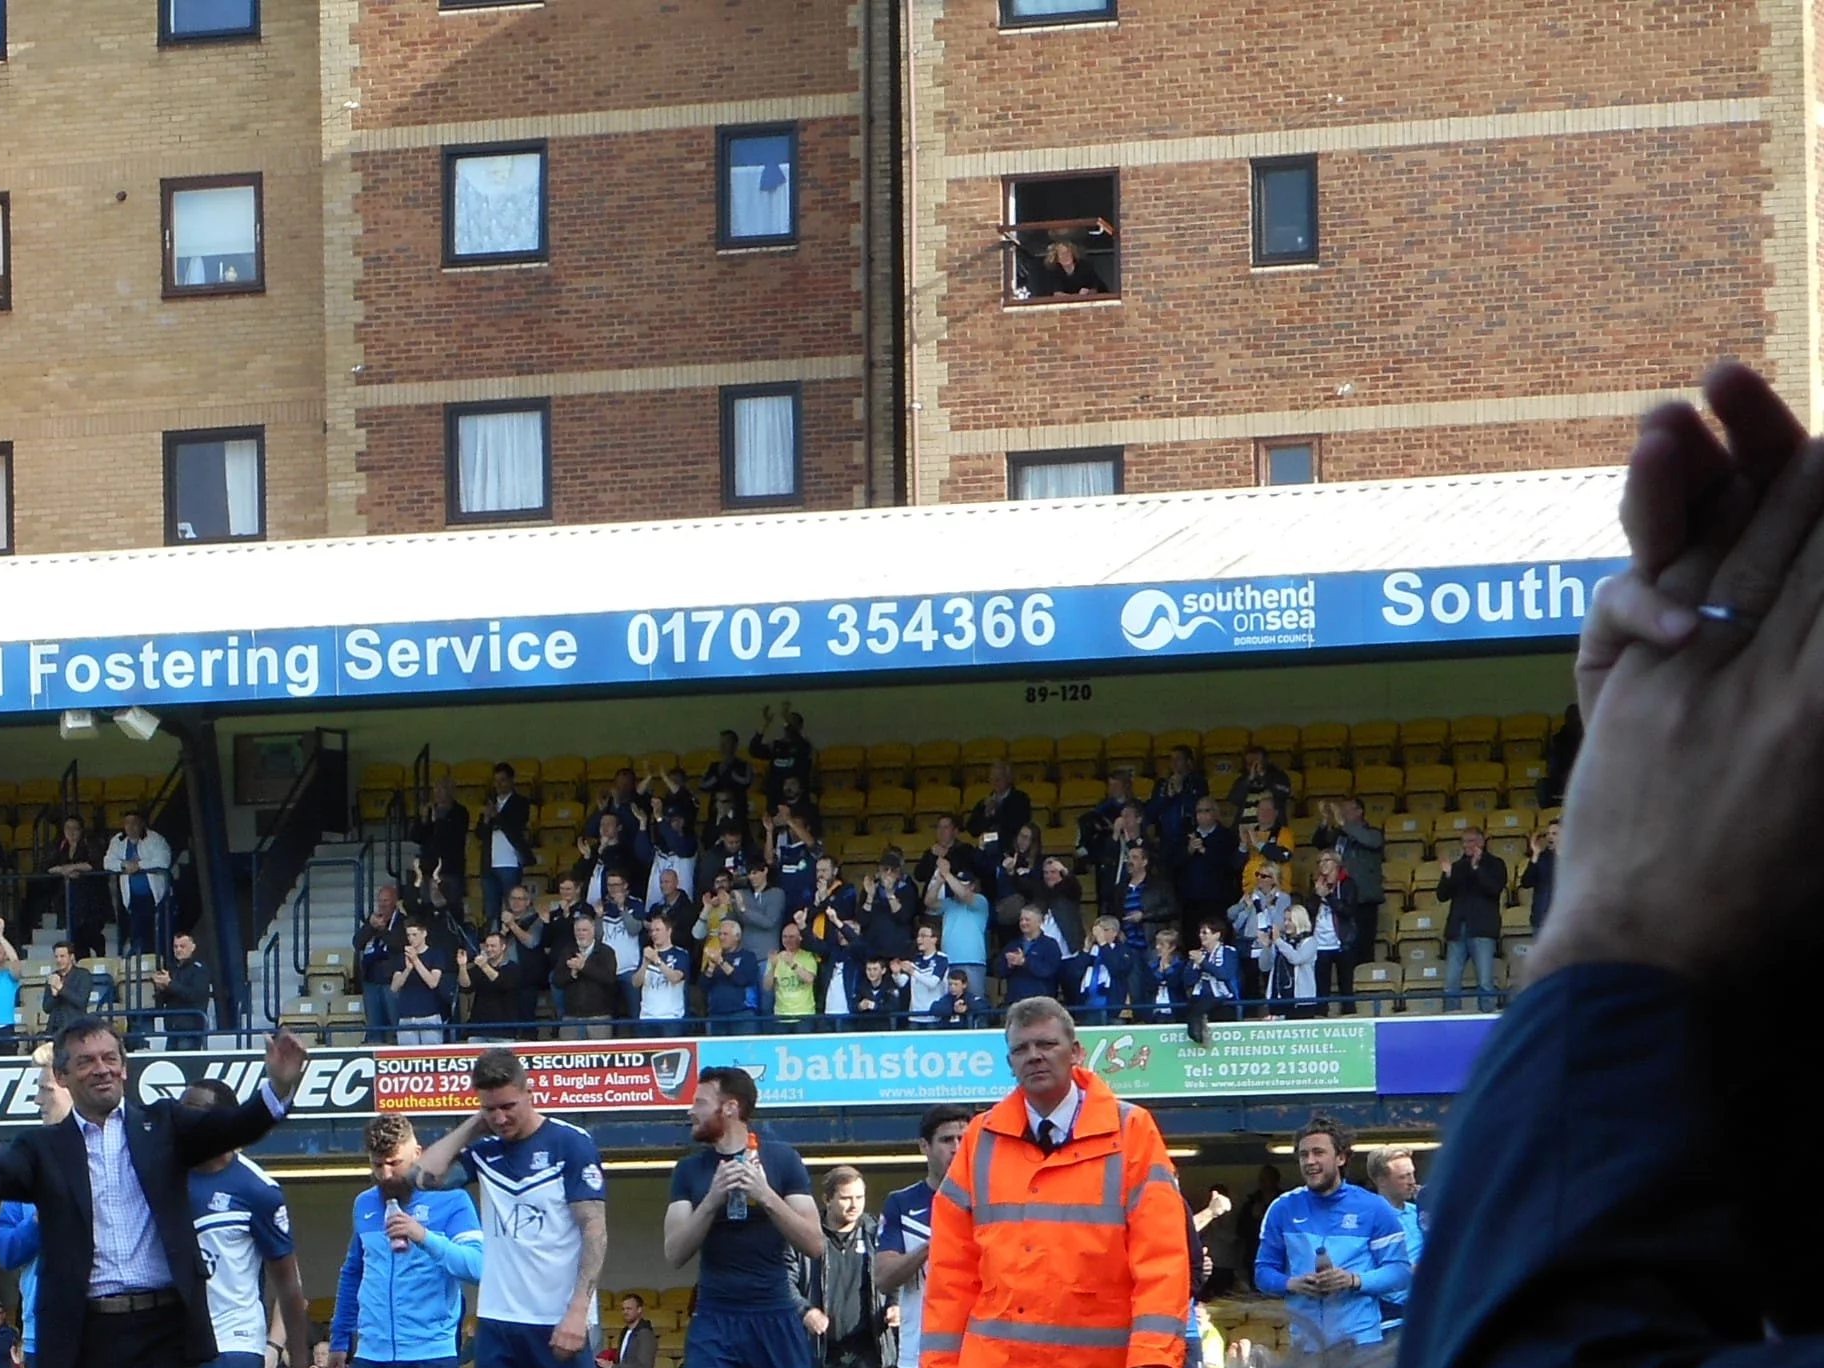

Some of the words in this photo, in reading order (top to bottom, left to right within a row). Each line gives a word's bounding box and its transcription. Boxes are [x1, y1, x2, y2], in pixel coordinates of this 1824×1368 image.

[1182, 580, 1316, 614] southend
[1382, 564, 1610, 627] South
[1233, 608, 1317, 632] onsea
[30, 636, 319, 697] Fostering
[345, 621, 578, 681] Service
[626, 606, 802, 665] 01702
[826, 593, 1056, 657] 354366
[1233, 634, 1276, 646] BOROUGH
[1277, 633, 1316, 644] COUNCIL
[1025, 684, 1093, 703] 89-120
[1208, 1031, 1246, 1042] OOD,
[1250, 1028, 1320, 1040] FANTASTIC
[1323, 1027, 1365, 1038] VALUE
[1177, 1047, 1206, 1058] AND
[1210, 1047, 1220, 1057] A
[1224, 1044, 1287, 1057] FRIENDLY
[378, 1059, 435, 1074] SOUTH
[437, 1057, 478, 1073] EAST
[532, 1053, 613, 1070] SECURITY
[614, 1052, 645, 1068] LTD
[775, 1043, 994, 1082] bathstore
[1184, 1063, 1213, 1077] Tel:
[1218, 1062, 1271, 1076] 01702
[1277, 1060, 1340, 1075] 213000
[378, 1076, 435, 1094] 01702
[438, 1074, 473, 1092] 329
[538, 1074, 550, 1088] &
[552, 1072, 601, 1089] Burglar
[604, 1072, 651, 1086] Alarms
[559, 1091, 603, 1104] Access
[604, 1089, 654, 1103] Control
